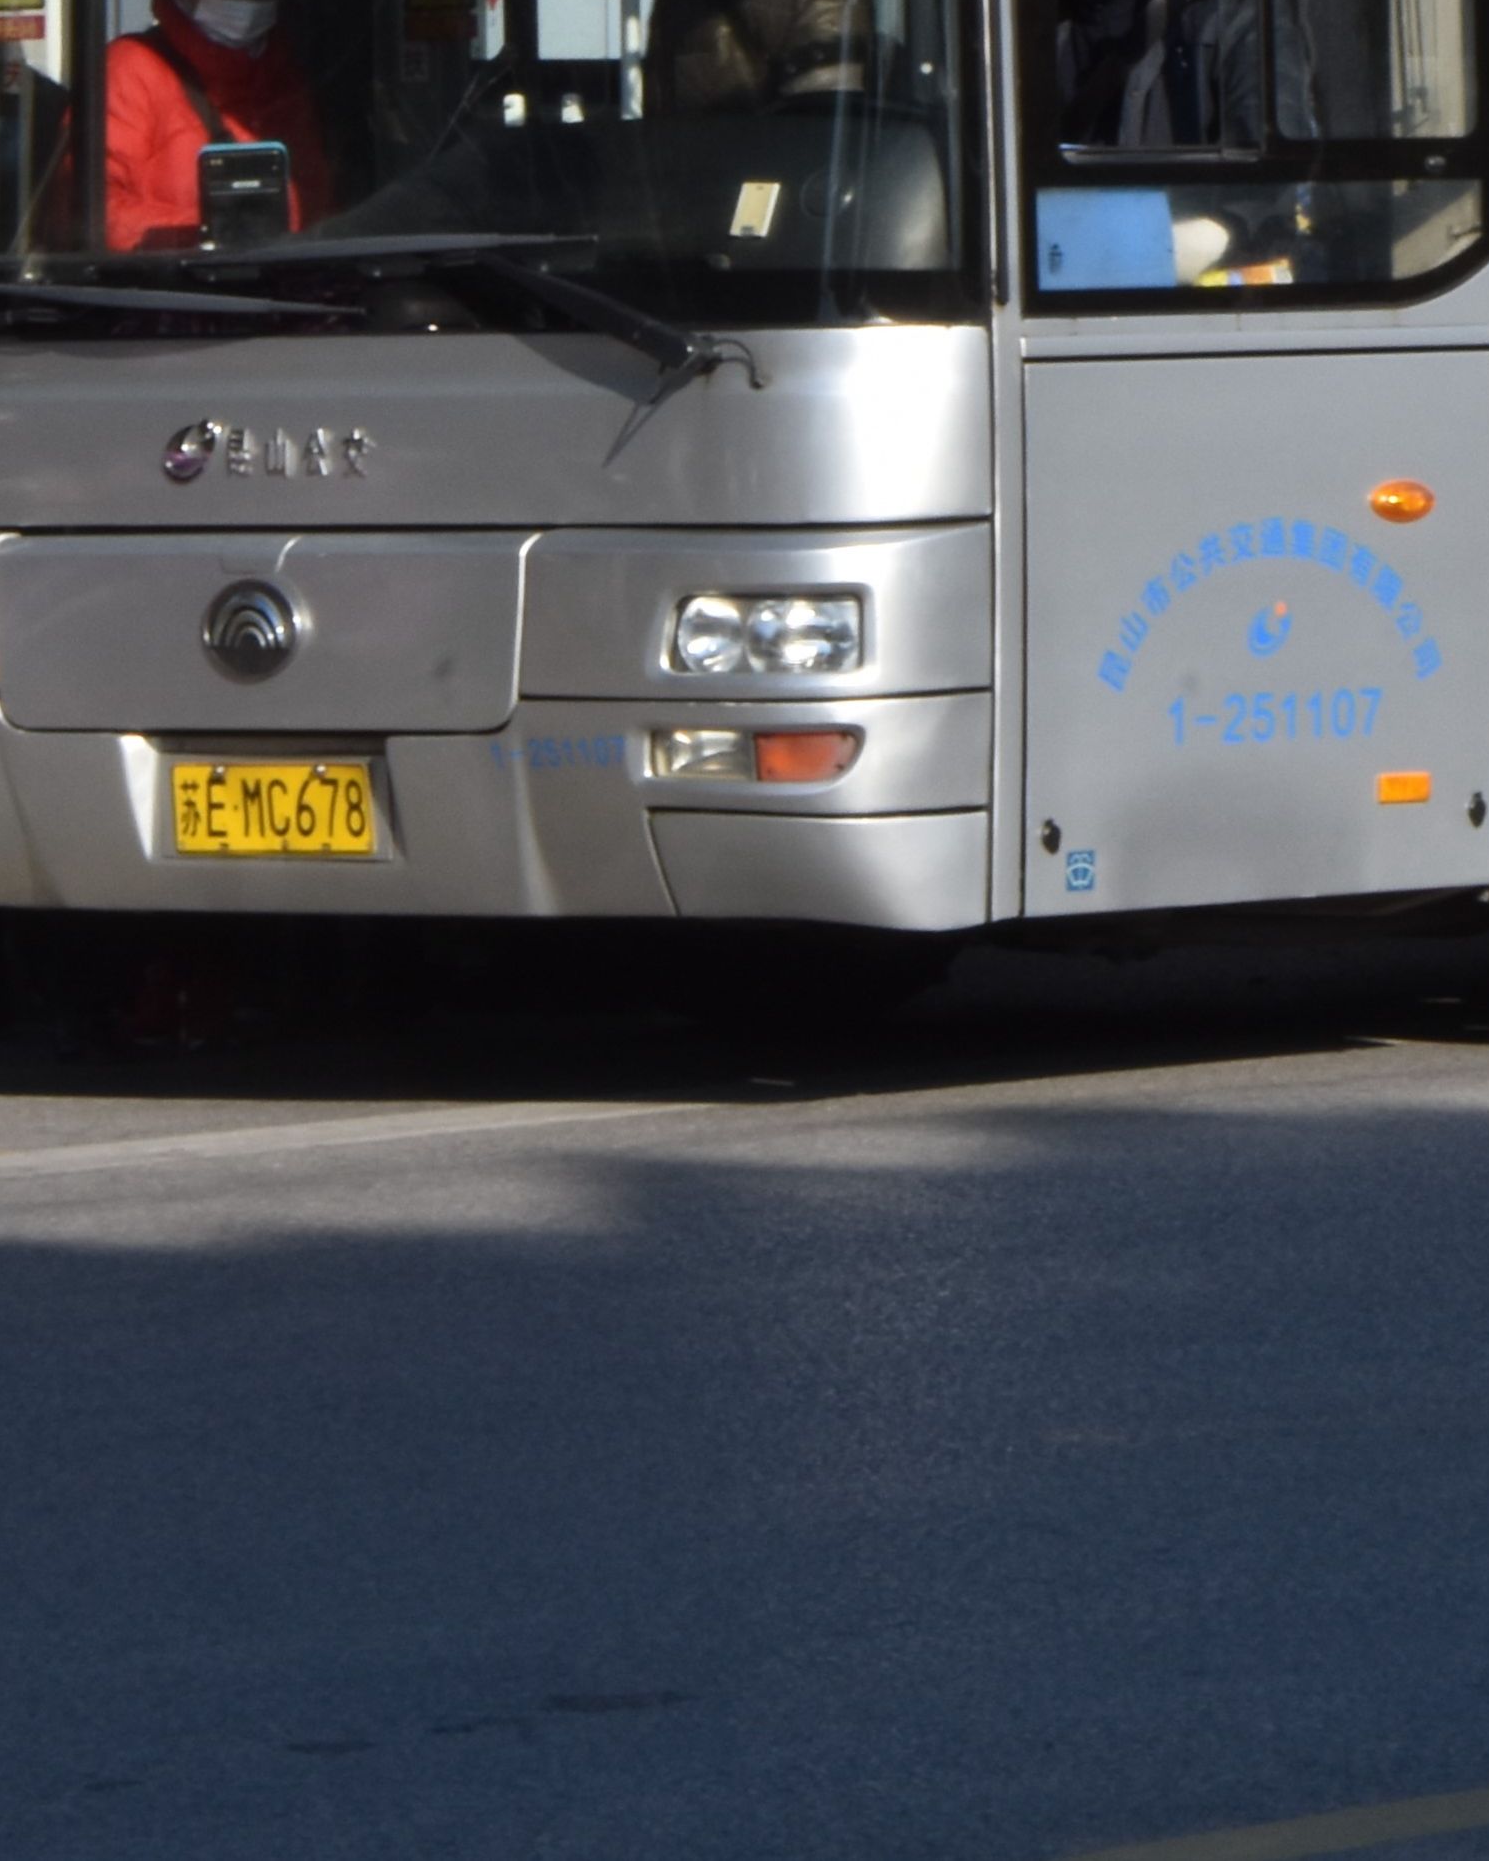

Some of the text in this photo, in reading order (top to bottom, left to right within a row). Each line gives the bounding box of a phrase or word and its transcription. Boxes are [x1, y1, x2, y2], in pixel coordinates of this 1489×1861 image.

[225, 424, 378, 479] 昆山公交
[1168, 687, 1383, 746] 1-251107
